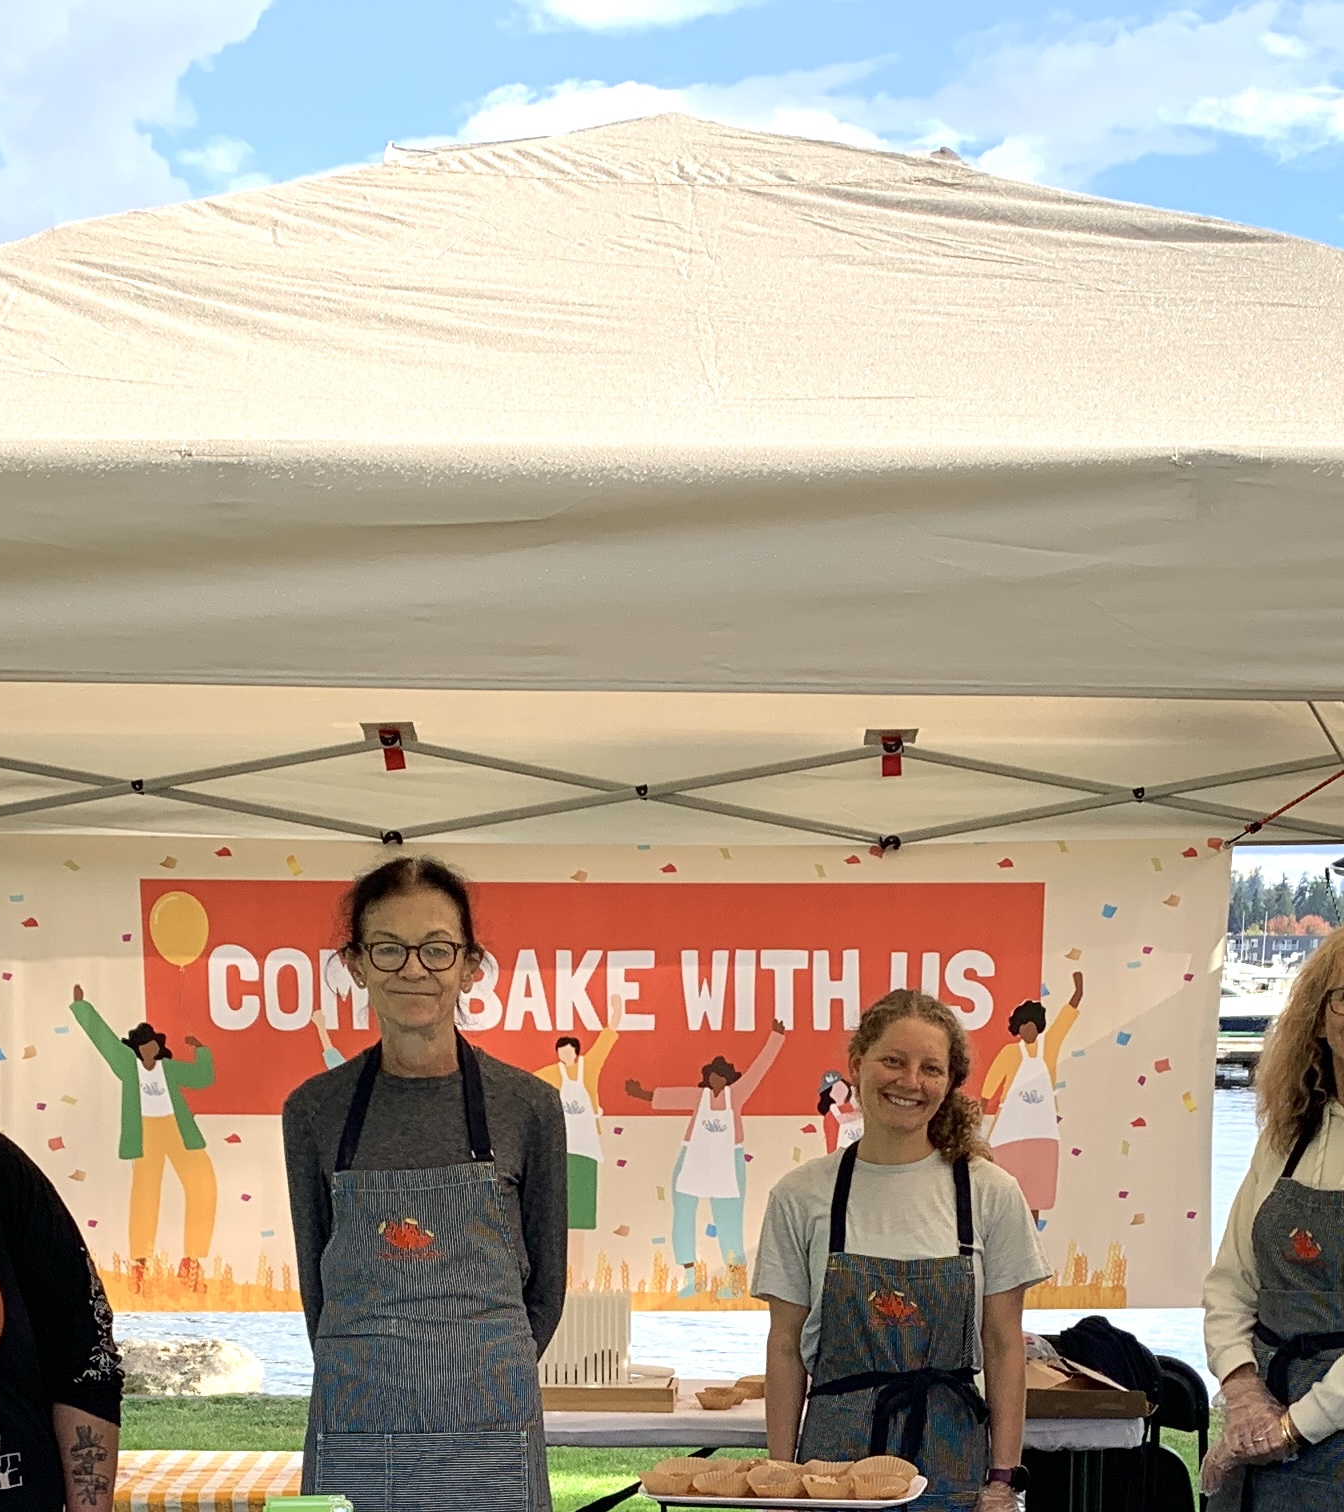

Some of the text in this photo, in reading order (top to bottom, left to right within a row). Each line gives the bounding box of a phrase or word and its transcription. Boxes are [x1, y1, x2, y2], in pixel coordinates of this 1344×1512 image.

[208, 944, 369, 1032] COM
[455, 949, 655, 1032] BAKE
[681, 949, 860, 1032] WITH
